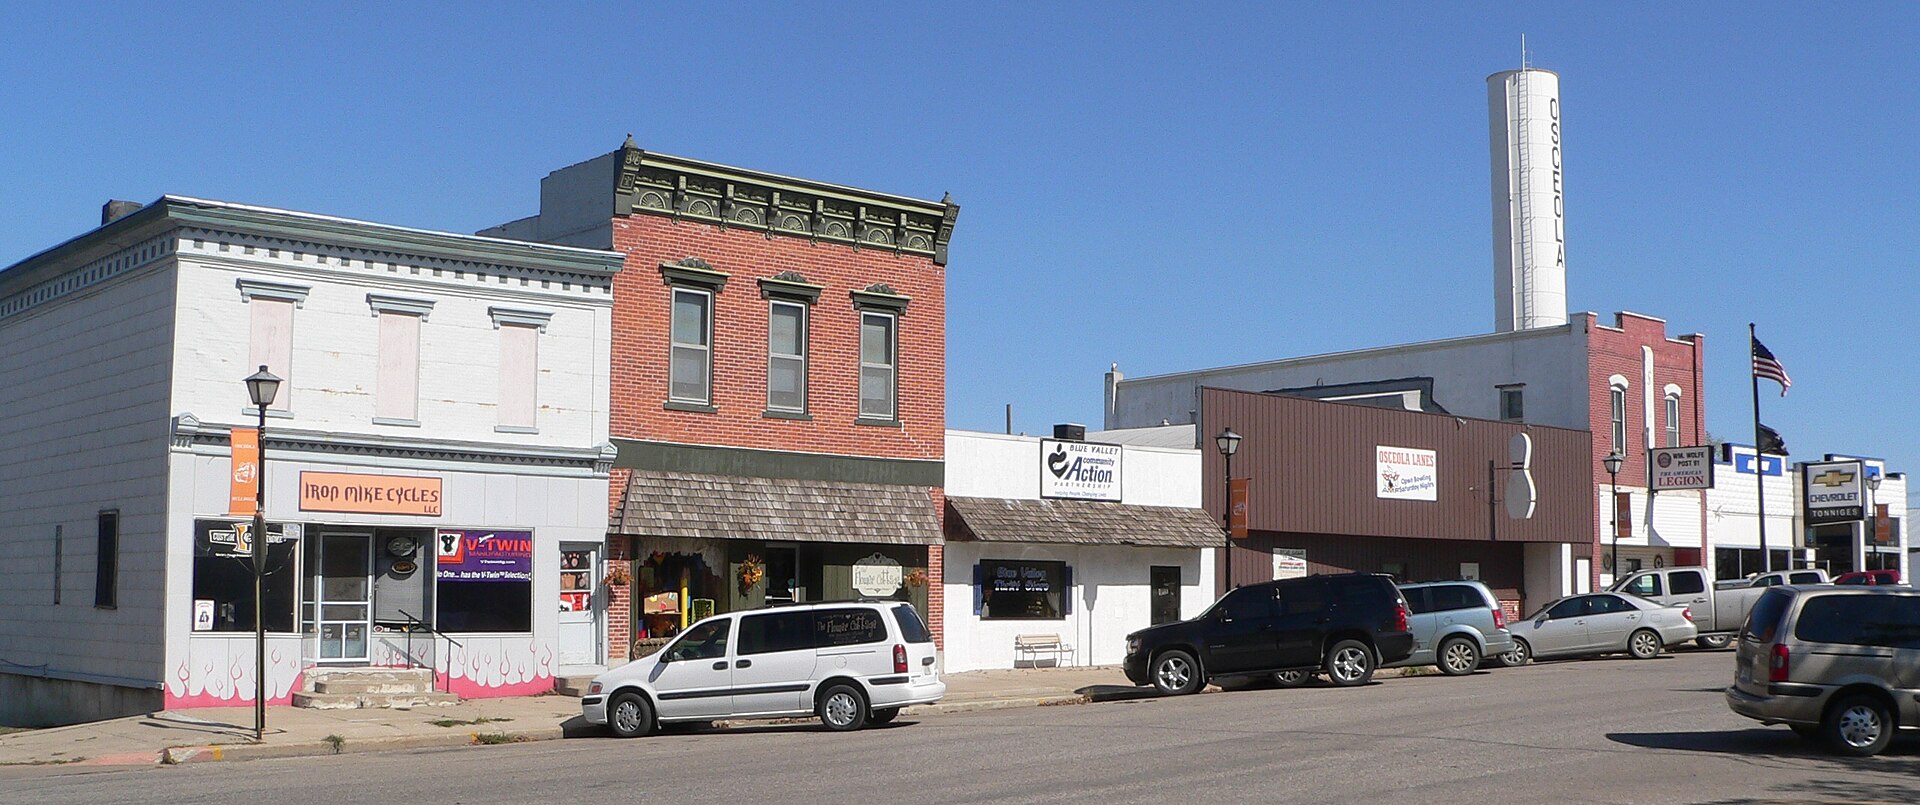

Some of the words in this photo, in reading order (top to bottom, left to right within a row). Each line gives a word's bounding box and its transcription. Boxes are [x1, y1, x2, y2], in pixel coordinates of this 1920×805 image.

[1550, 98, 1563, 267] OSCEOLA
[1070, 444, 1088, 453] BLUE
[1091, 446, 1119, 456] VALLEY
[1687, 451, 1705, 459] WOLFE
[1083, 457, 1115, 467] community
[1379, 451, 1410, 465] OSCEOLA
[1412, 453, 1433, 467] LANES
[1064, 456, 1113, 484] Action
[1414, 474, 1431, 482] Bowling
[1658, 475, 1705, 487] LEGION
[1054, 481, 1111, 489] PARTNERSHIP
[305, 481, 339, 502] IRON
[344, 484, 384, 503] MIKE
[386, 487, 440, 505] CYCLES
[1810, 492, 1858, 503] CHEVROLET
[423, 505, 439, 513] LLC
[1812, 508, 1858, 518] TONNIGES
[466, 538, 532, 552] V-TWIN
[469, 550, 531, 558] MANUFACTURING
[461, 570, 471, 579] has
[472, 571, 481, 579] the
